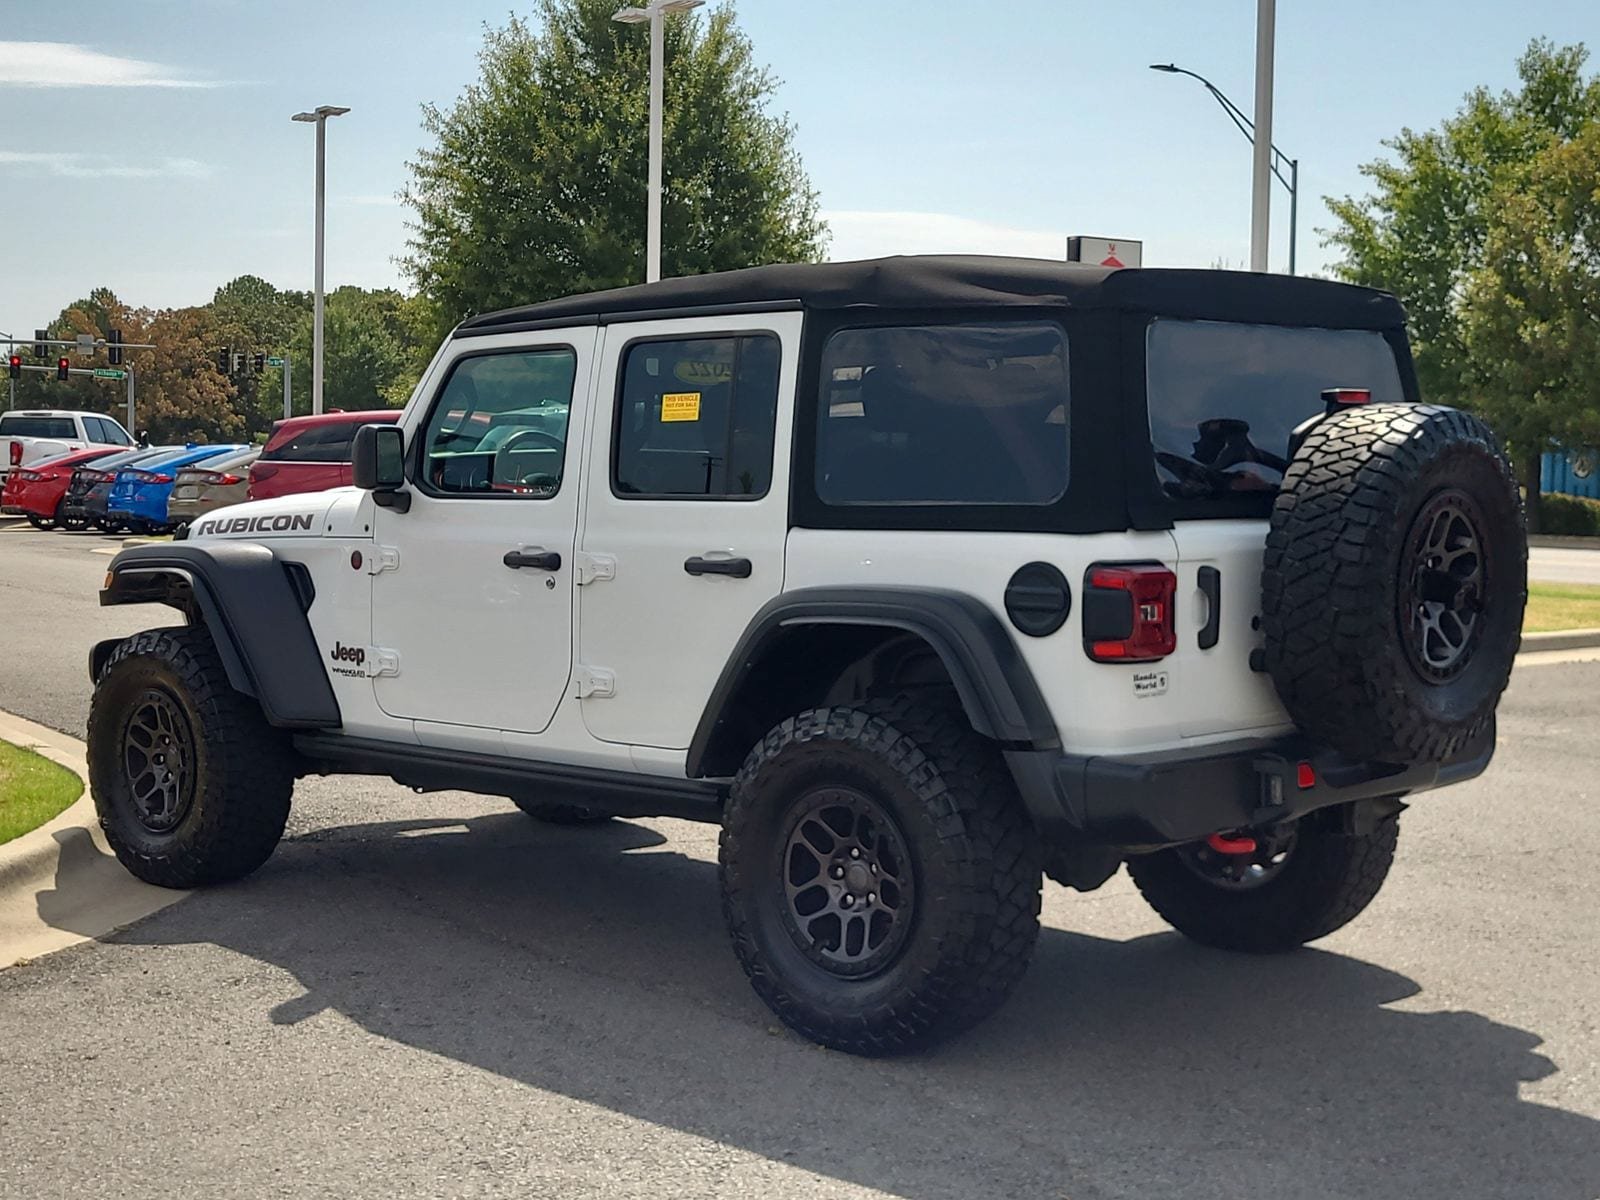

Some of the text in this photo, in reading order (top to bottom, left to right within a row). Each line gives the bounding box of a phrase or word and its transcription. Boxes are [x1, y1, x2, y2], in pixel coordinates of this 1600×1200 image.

[678, 394, 698, 402] VEHICLE
[198, 514, 314, 536] RUBICON
[331, 641, 365, 666] Jeep
